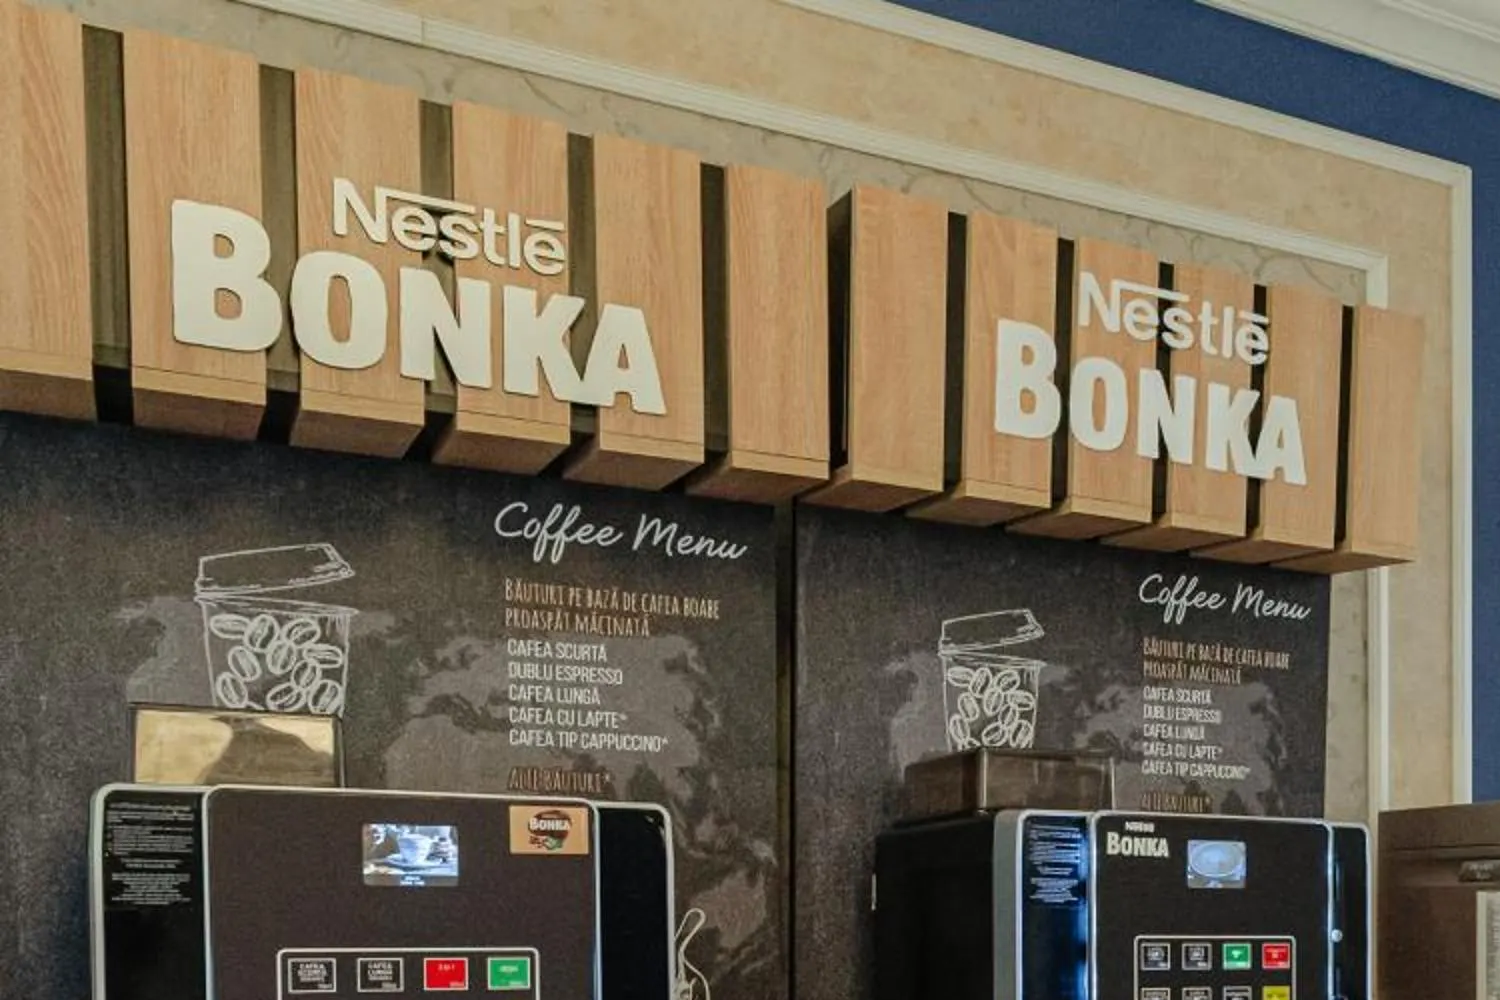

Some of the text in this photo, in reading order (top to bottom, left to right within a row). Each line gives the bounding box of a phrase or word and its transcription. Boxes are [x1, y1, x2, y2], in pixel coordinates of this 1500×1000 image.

[171, 199, 667, 416] BONKA
[994, 318, 1307, 486] BONKA
[494, 501, 748, 564] Coffee Menu
[569, 586, 583, 607] PE
[623, 591, 638, 612] DE
[641, 592, 679, 615] CAFEA
[1139, 573, 1311, 625] Coffee Menu
[507, 638, 553, 658] CAFEA
[507, 662, 623, 685] DUBLU ESPRESSO
[508, 684, 554, 703] CAFEA
[1143, 685, 1174, 702] CAFEA
[509, 707, 554, 726] CAFEA
[557, 709, 574, 727] CU
[509, 729, 554, 746] CAFEA
[558, 731, 578, 749] TIP
[1143, 723, 1173, 739] CAFEA
[1142, 741, 1173, 758] CAFEA
[1141, 759, 1173, 775] CAFEA
[1106, 831, 1170, 857] BONKA
